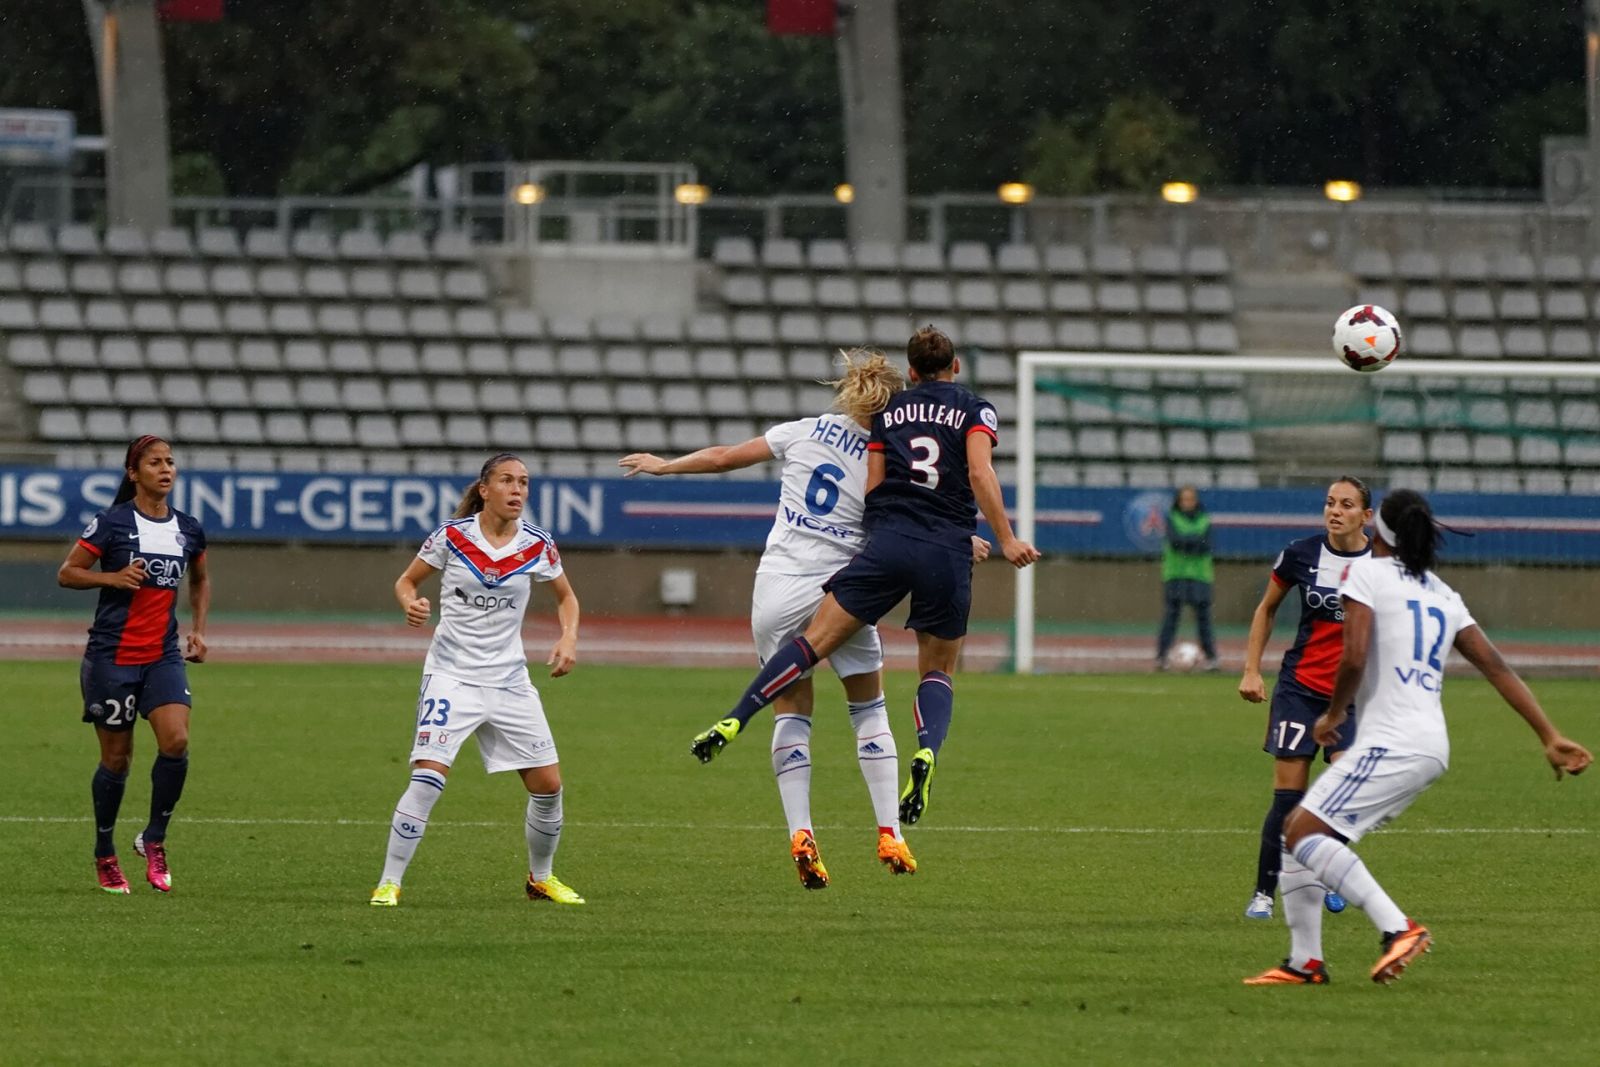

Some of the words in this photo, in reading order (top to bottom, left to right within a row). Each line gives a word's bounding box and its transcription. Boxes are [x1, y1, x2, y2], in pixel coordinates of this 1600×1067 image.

[883, 403, 967, 430] BOULLEAU
[810, 418, 868, 461] HENR
[909, 436, 940, 490] 3
[804, 463, 846, 516] 6
[474, 595, 517, 611] april
[1406, 599, 1447, 673] 12
[105, 694, 136, 725] 28
[420, 698, 450, 726] 23
[1278, 720, 1306, 750] 17
[401, 822, 418, 833] OL
